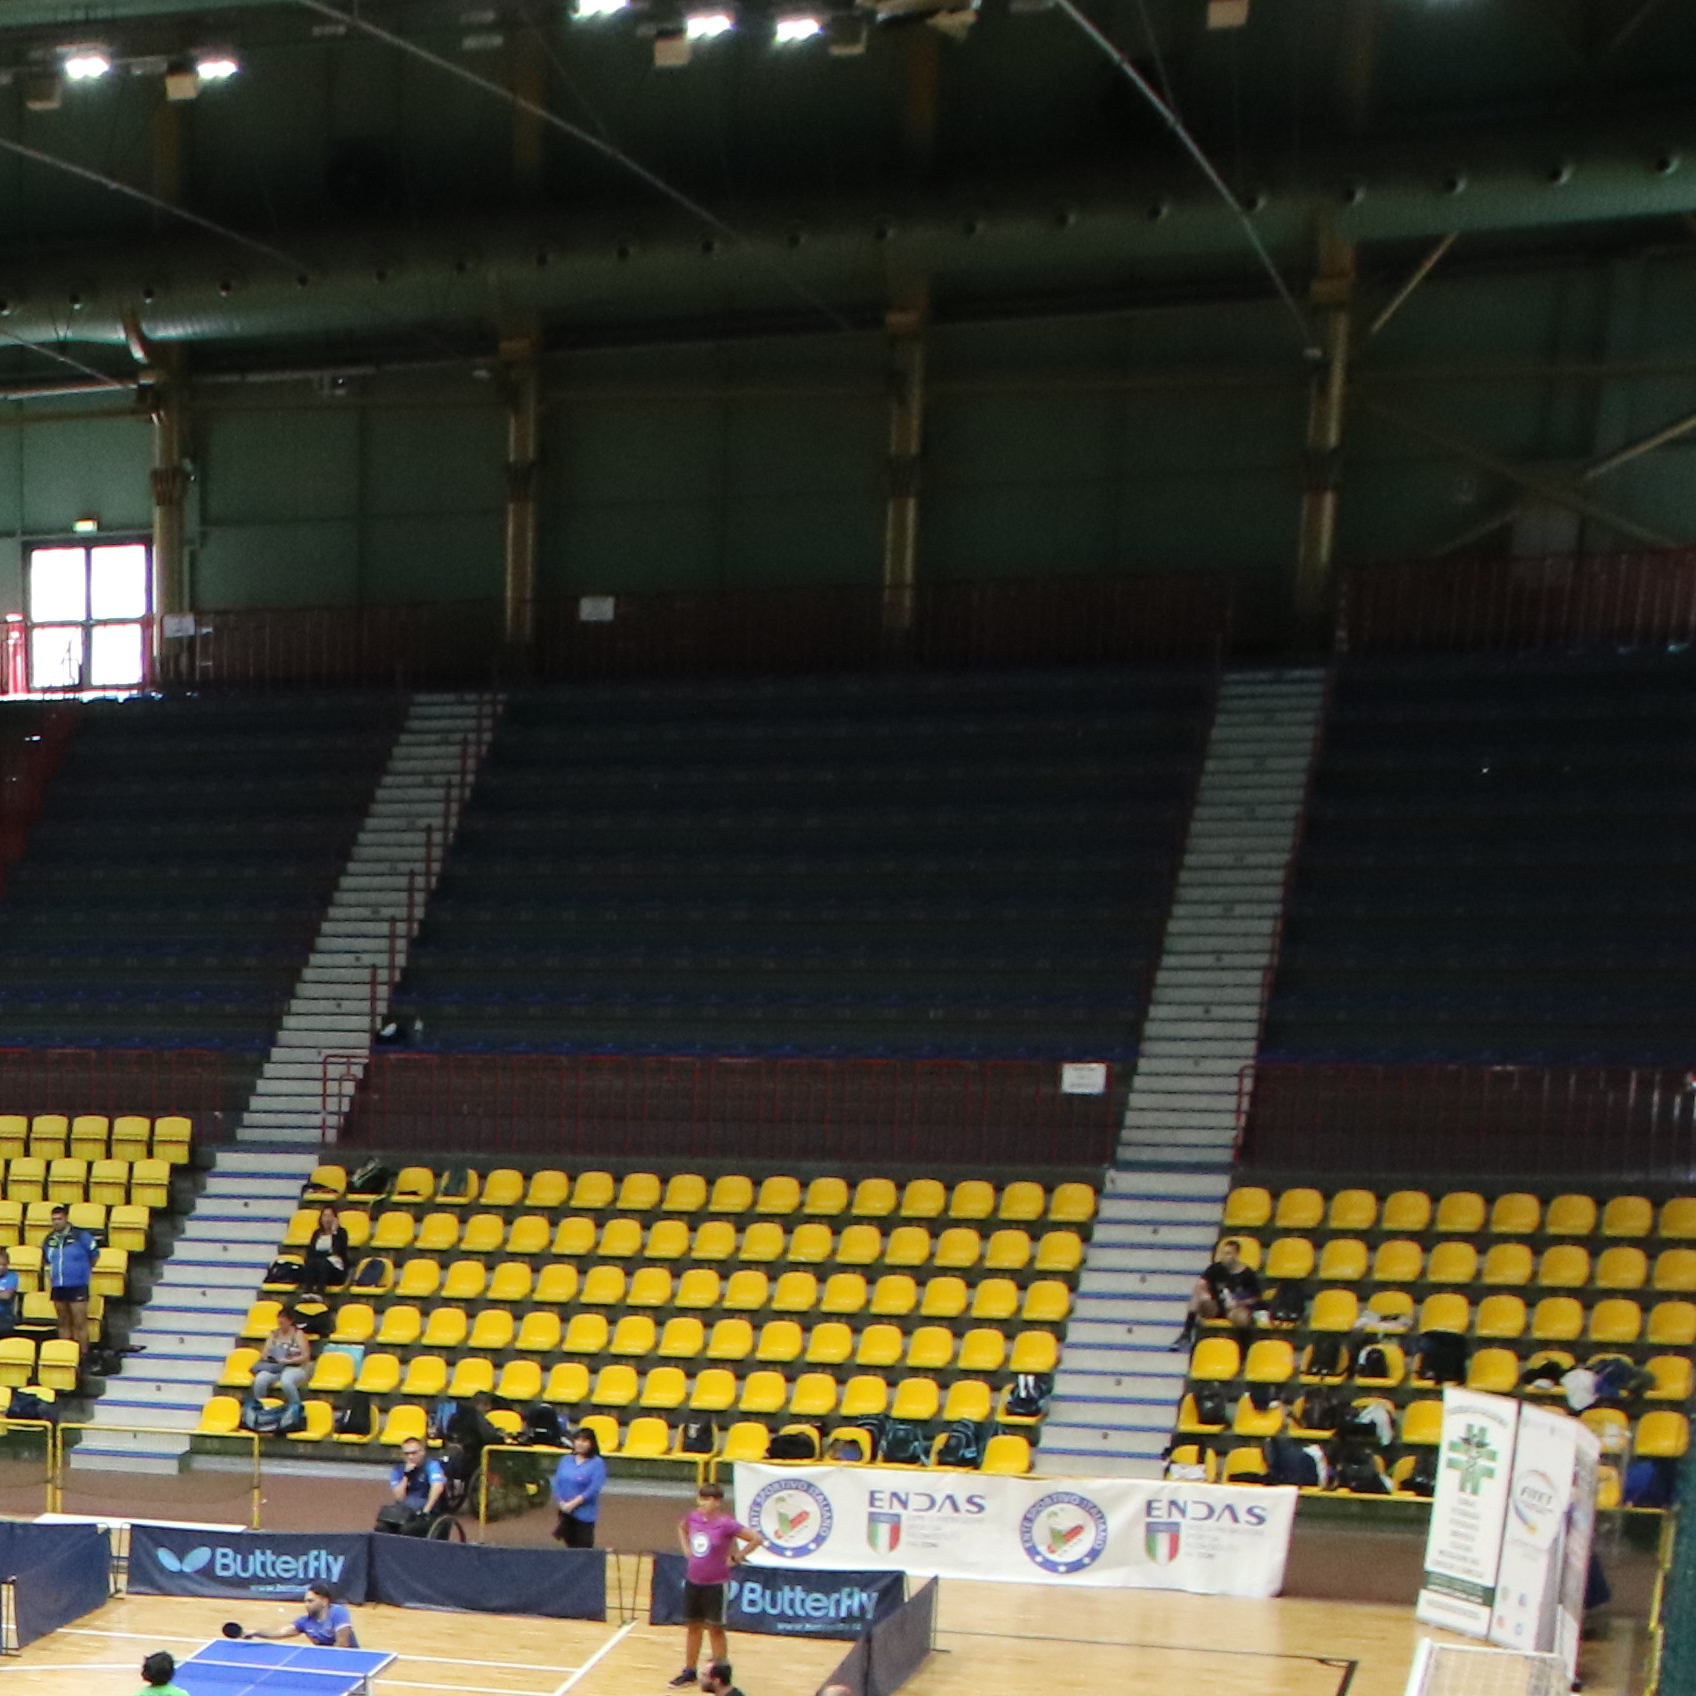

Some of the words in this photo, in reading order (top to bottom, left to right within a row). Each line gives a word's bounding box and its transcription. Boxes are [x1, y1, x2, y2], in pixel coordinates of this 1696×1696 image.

[868, 1489, 986, 1514] ENDAS
[1145, 1499, 1267, 1526] ENDAS
[213, 1548, 345, 1584] Butterfly
[742, 1582, 879, 1619] Butterfly
